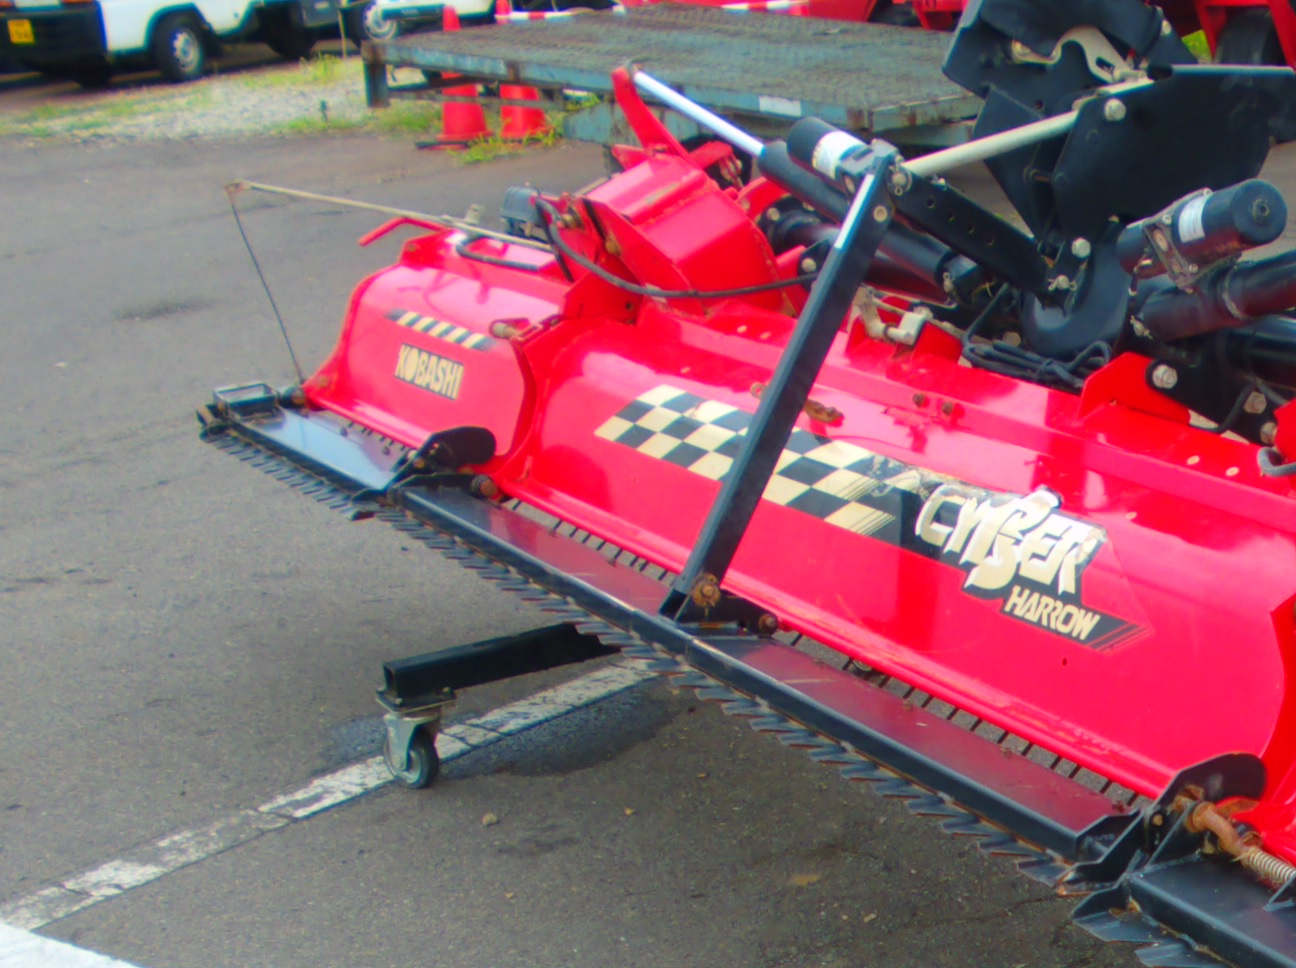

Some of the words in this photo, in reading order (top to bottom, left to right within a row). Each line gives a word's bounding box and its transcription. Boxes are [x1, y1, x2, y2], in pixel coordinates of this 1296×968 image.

[395, 344, 464, 400] KOBASHI
[915, 484, 1106, 595] CYBER
[1004, 585, 1100, 640] HARROW
